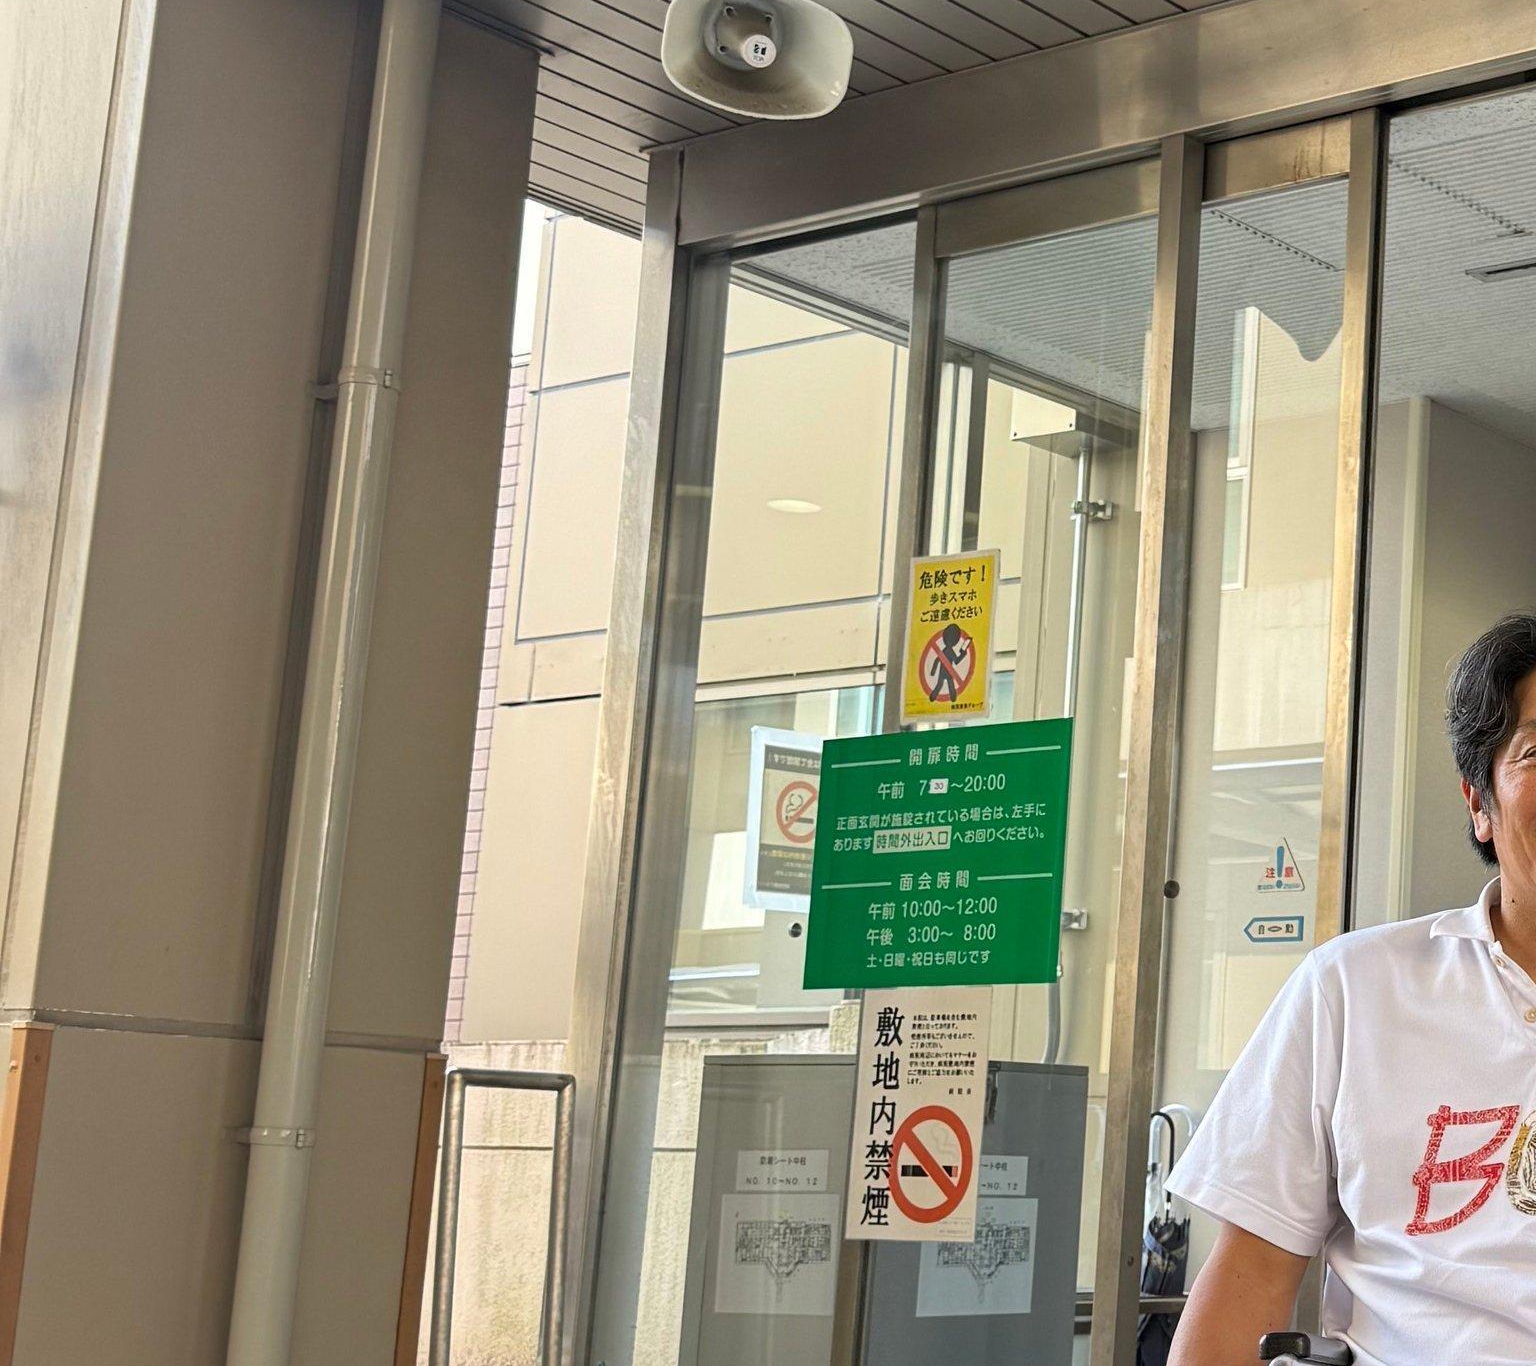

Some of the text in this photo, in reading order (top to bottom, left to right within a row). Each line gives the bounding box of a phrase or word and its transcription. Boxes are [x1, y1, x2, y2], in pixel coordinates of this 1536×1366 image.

[930, 588, 978, 606] 歩きスマホ
[920, 605, 983, 623] ご遠慮ください
[908, 743, 980, 766] 開扉時間
[877, 781, 905, 800] 午前
[836, 802, 1046, 831] 正面玄関が施錠されている場合は、左手に
[833, 826, 1046, 853] あります時間外出入口へお回りください。
[899, 869, 970, 891] 面会時間
[868, 896, 998, 921] 午前 10:00～12:00
[866, 928, 894, 946] 午後
[866, 949, 991, 969] 土・日曜・祝日も同じです
[860, 1006, 905, 1226] 敷地内禁煙
